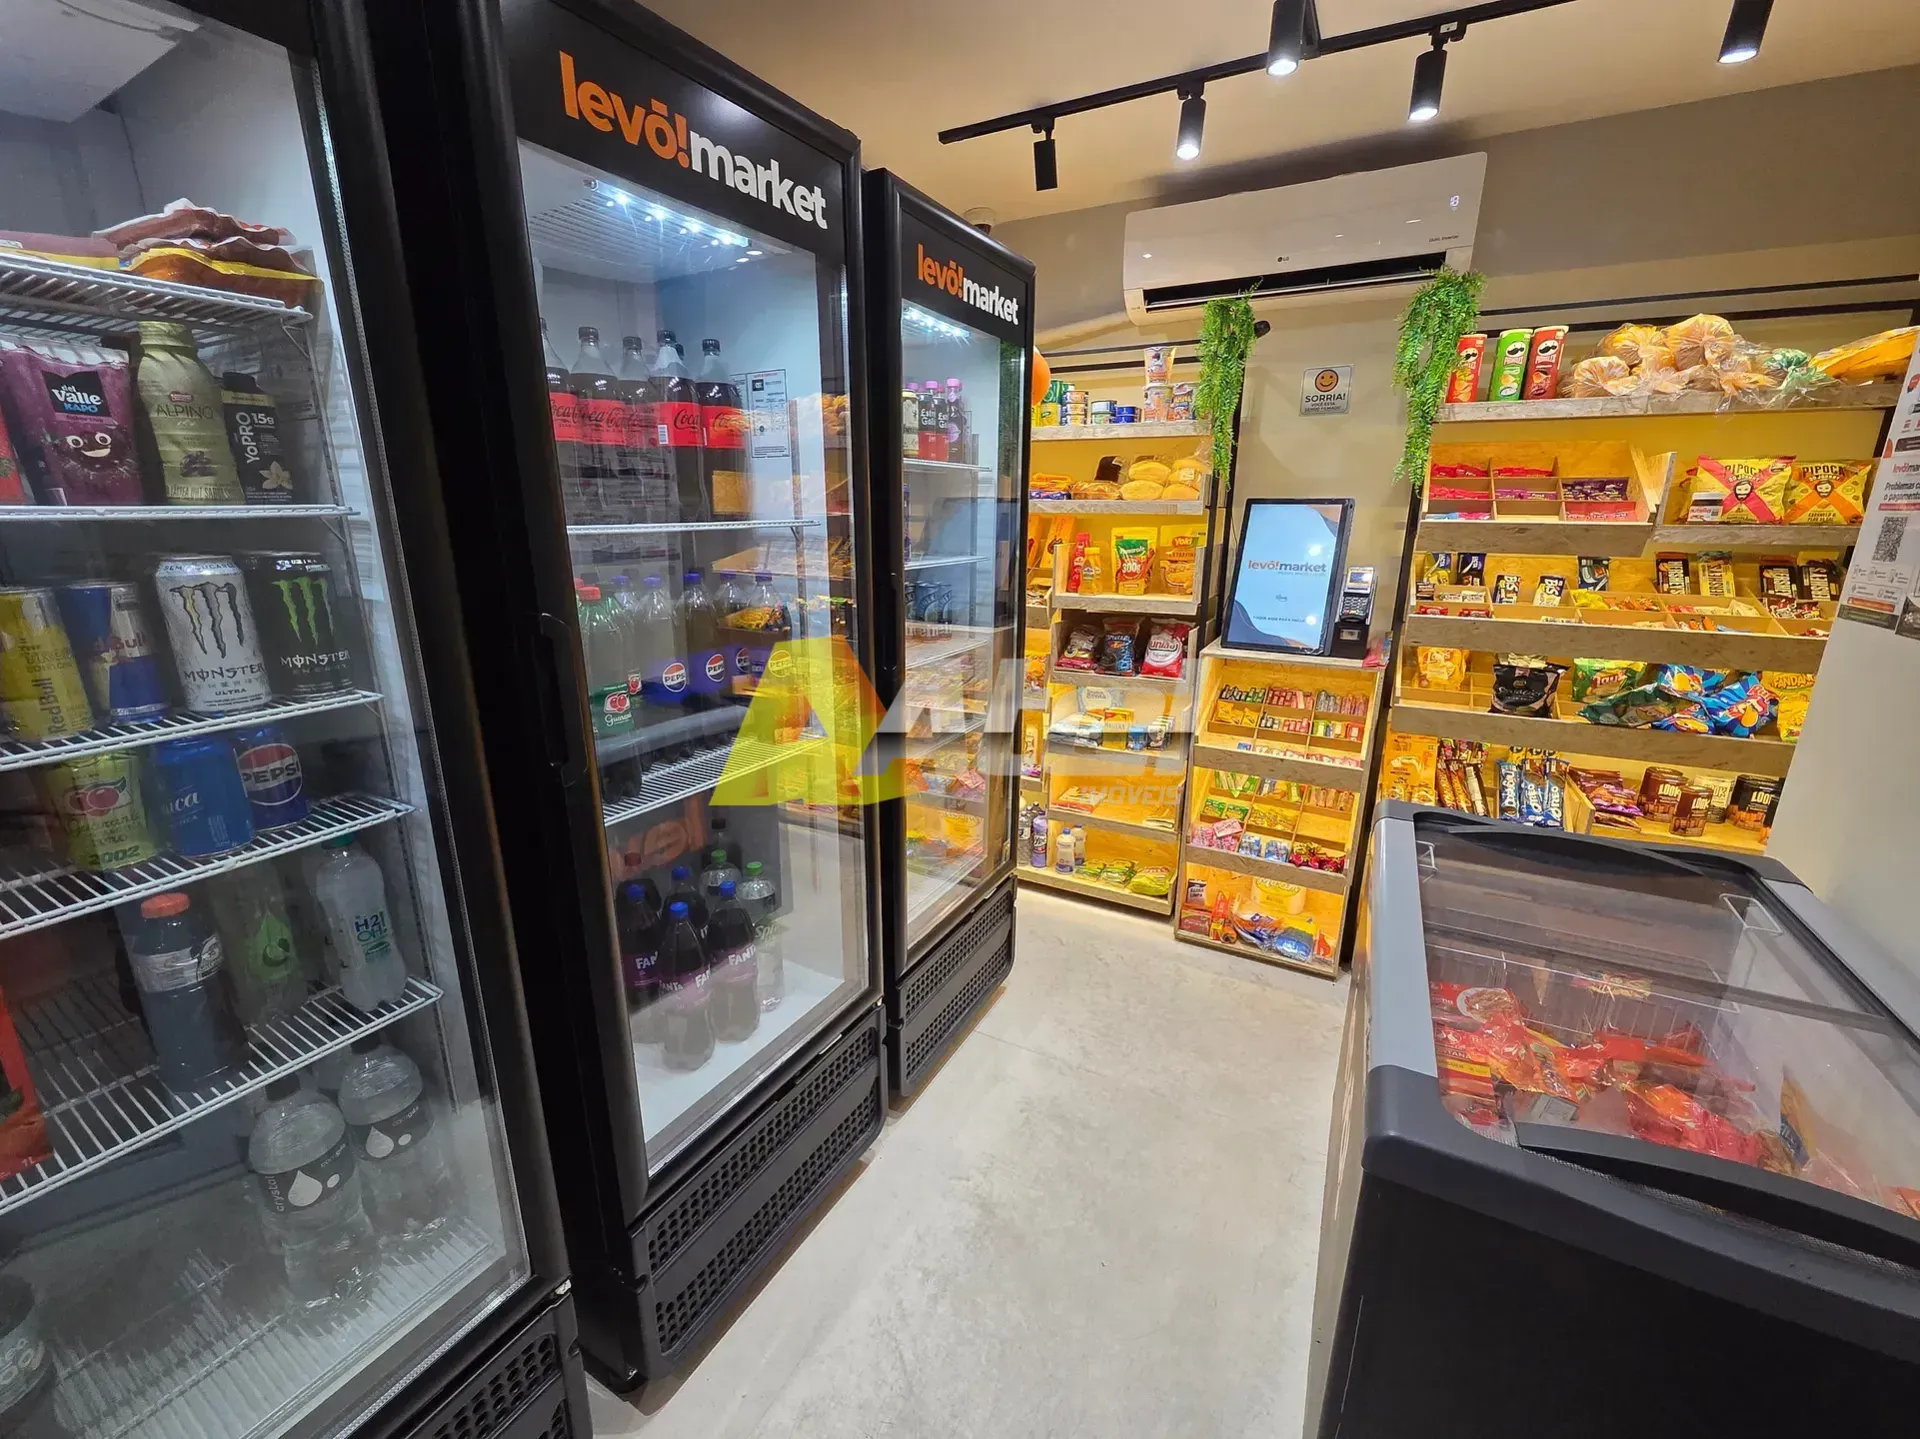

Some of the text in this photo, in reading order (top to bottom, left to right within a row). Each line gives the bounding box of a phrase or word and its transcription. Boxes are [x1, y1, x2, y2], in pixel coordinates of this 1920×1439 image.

[51, 388, 103, 405] Valle
[1304, 392, 1347, 403] SORRIA!
[156, 404, 215, 420] ALPINO
[251, 412, 275, 425] 15g
[235, 411, 260, 464] YoPRO
[1884, 481, 1914, 491] Problemas
[280, 649, 350, 669] MONSTER
[183, 661, 265, 683] MONSTER
[215, 687, 247, 697] ULTRA
[1691, 797, 1711, 810] LOOK
